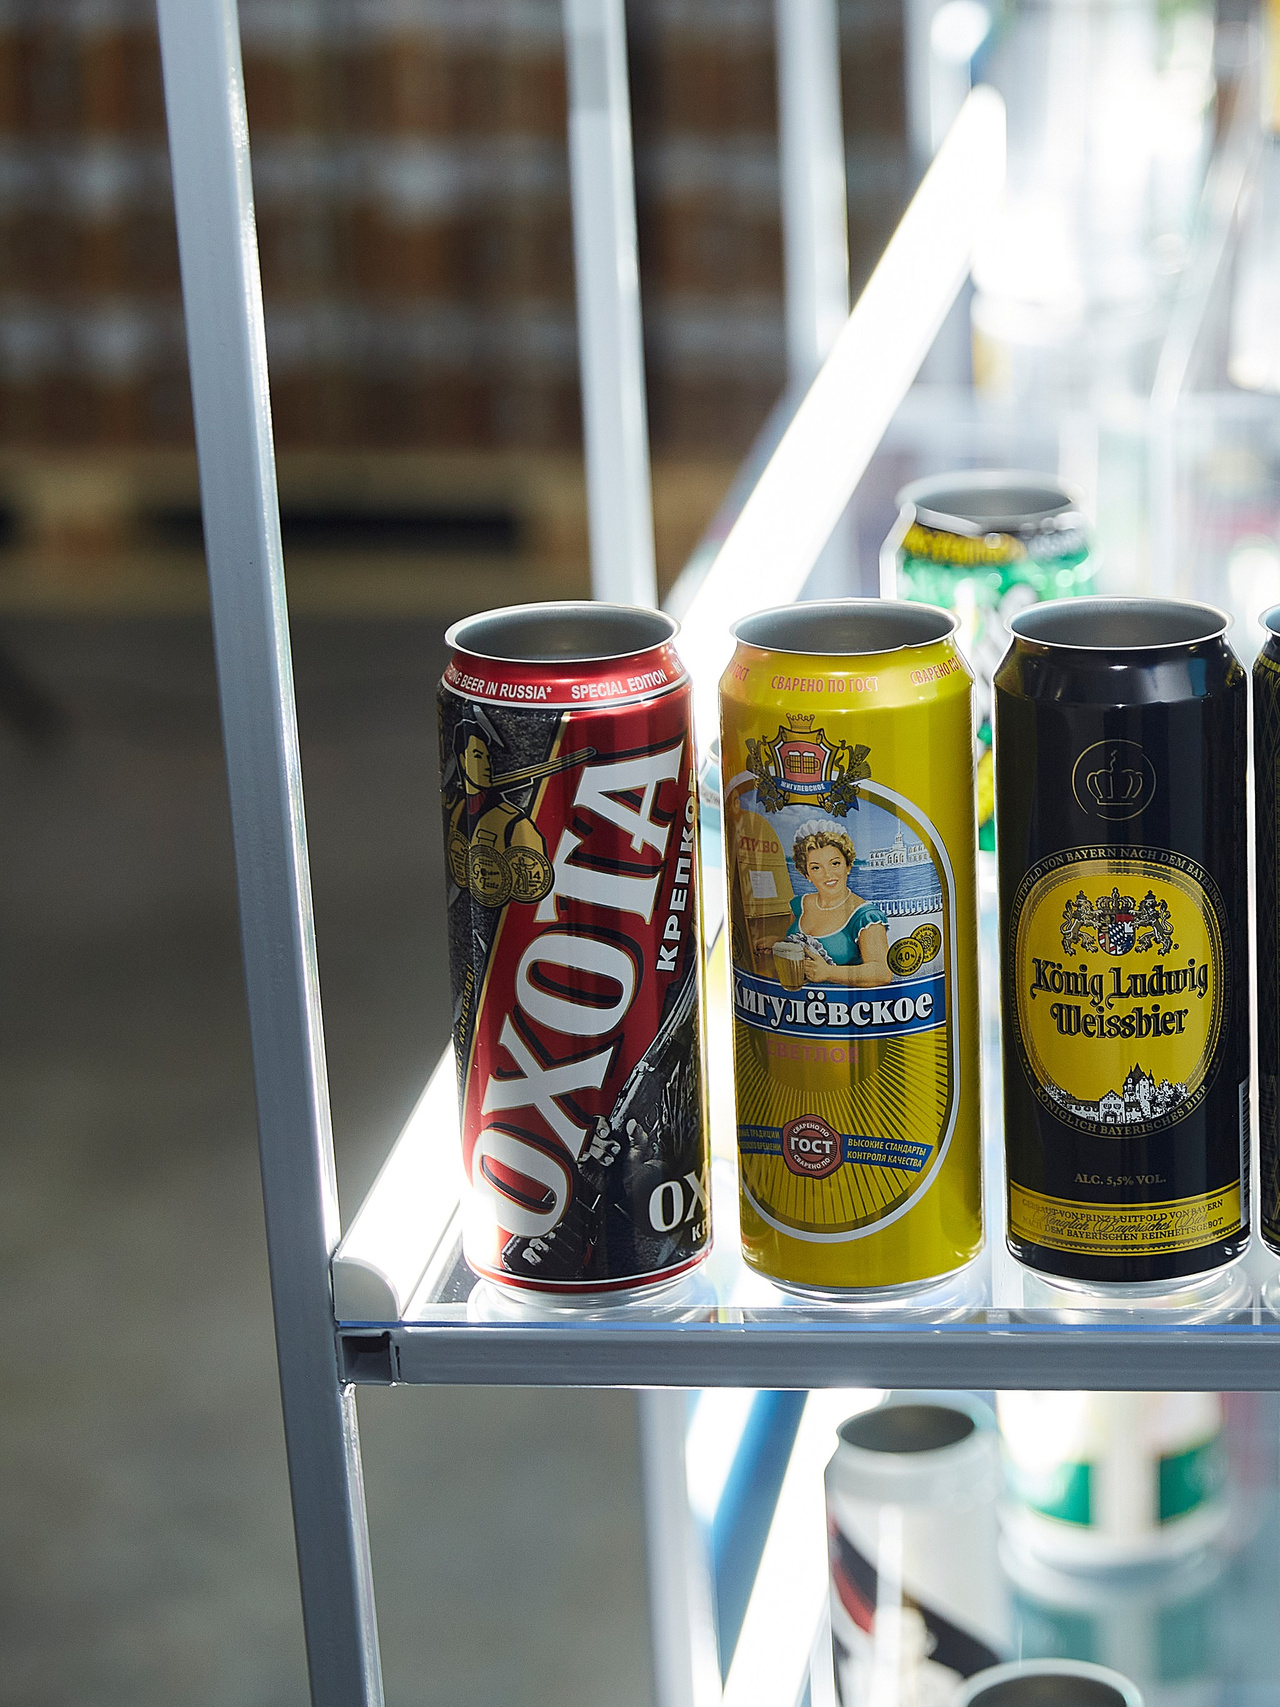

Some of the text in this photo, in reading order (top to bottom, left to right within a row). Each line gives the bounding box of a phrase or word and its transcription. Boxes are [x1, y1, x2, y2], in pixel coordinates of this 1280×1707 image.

[460, 674, 485, 694] BEER
[485, 681, 499, 696] IN
[571, 668, 668, 700] SPECIAL EDITION
[771, 675, 879, 694] СВАРЕНО ПО ГОСТ
[909, 661, 950, 686] СВАРЕНО
[740, 834, 779, 855] ПИВО
[1014, 867, 1043, 915] LUITPOLD
[1042, 855, 1065, 871] VON
[1066, 848, 1117, 861] BAYERN
[1120, 848, 1157, 860] NACH
[1160, 852, 1185, 869] DEM
[473, 739, 684, 1238] ОХОТА
[1030, 957, 1209, 1011] König Ludwig
[1050, 1002, 1189, 1039] Weissbier
[1100, 1107, 1186, 1136] BAYERISCHES
[1185, 1084, 1209, 1109] BIER
[793, 1122, 830, 1138] СВАРЕНО ПО
[790, 1136, 833, 1154] ГОСТ
[848, 1138, 927, 1157] ВЫСОКИЕ СТАНДАРТЫ
[793, 1154, 831, 1170] СВАРЕНО ПО
[847, 1150, 922, 1168] КОНТРОЛЯ КАЧЕСТВА
[1074, 1172, 1167, 1187] ALC. 5,5% VOL.
[1059, 1210, 1079, 1220] VON
[1080, 1213, 1111, 1223] PRINZ
[1168, 1209, 1190, 1220] VON
[1191, 1199, 1224, 1215] BAYERN
[1045, 1224, 1064, 1236] DEM
[1066, 1228, 1138, 1241] BAYERISCHEN
[1141, 1217, 1224, 1240] REINHEITSGEBOT
